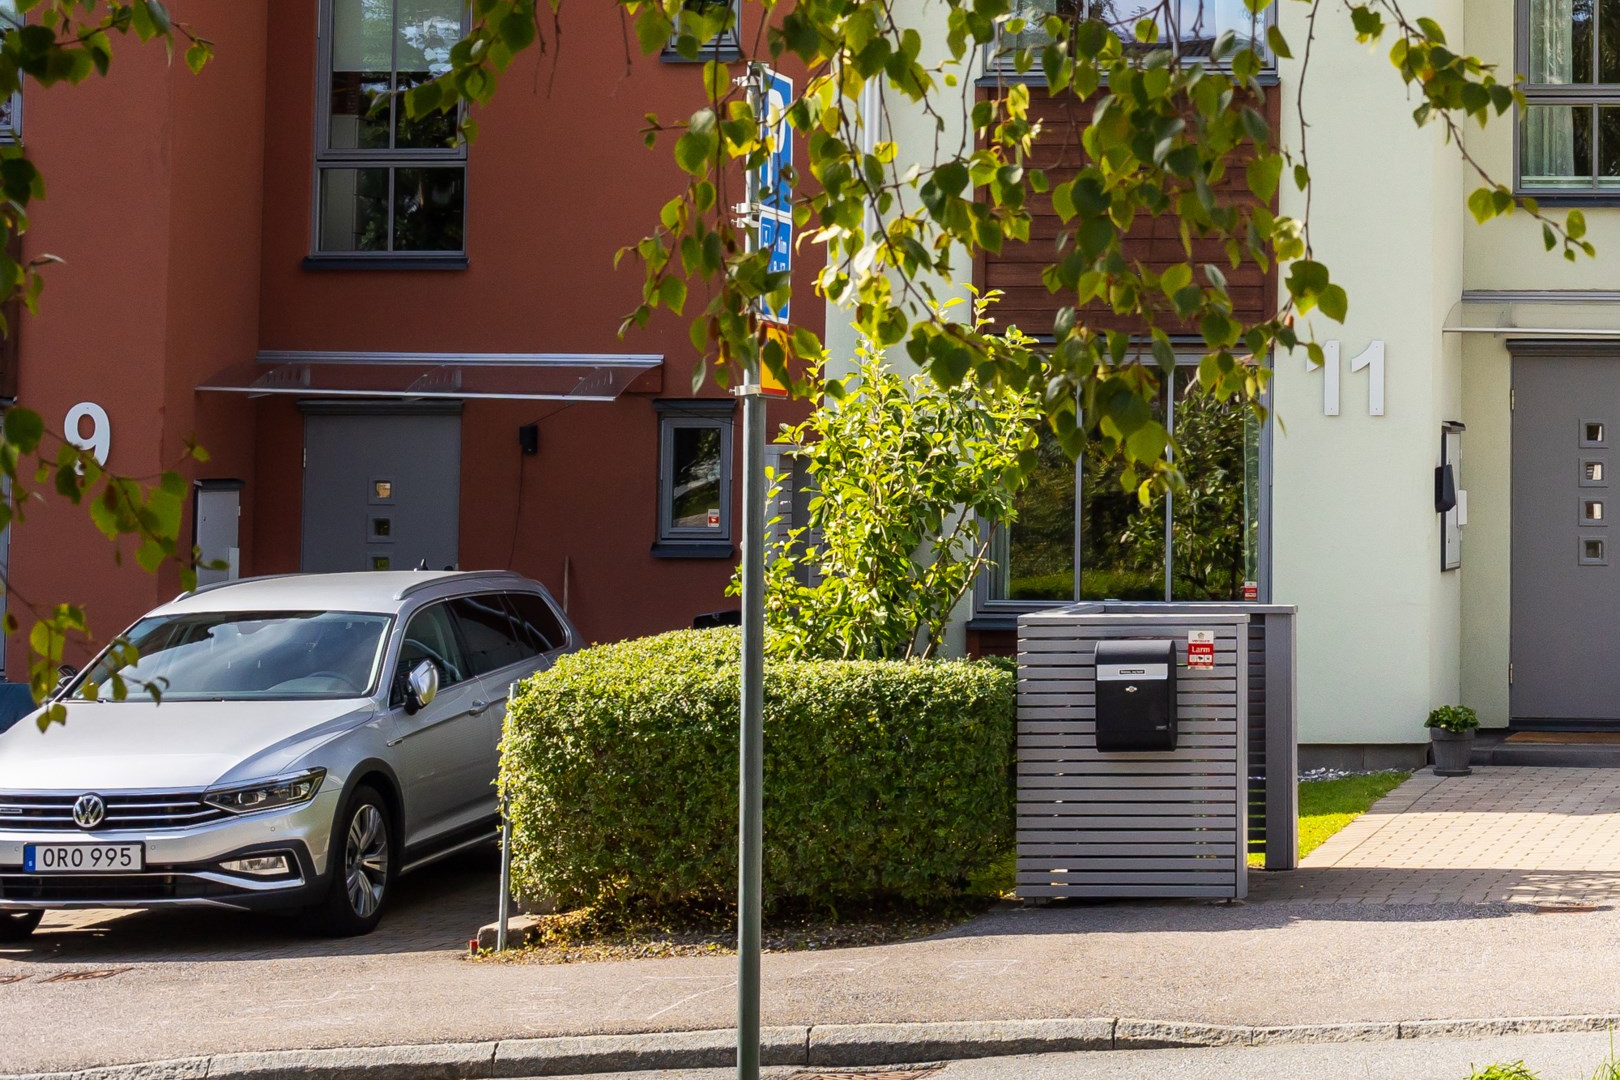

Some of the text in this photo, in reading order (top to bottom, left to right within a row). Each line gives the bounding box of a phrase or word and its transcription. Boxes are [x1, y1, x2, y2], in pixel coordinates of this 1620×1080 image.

[766, 88, 786, 194] P
[1306, 340, 1384, 416] 11
[64, 402, 111, 476] 9
[1191, 645, 1211, 653] Larm
[43, 847, 132, 868] ORO 995
